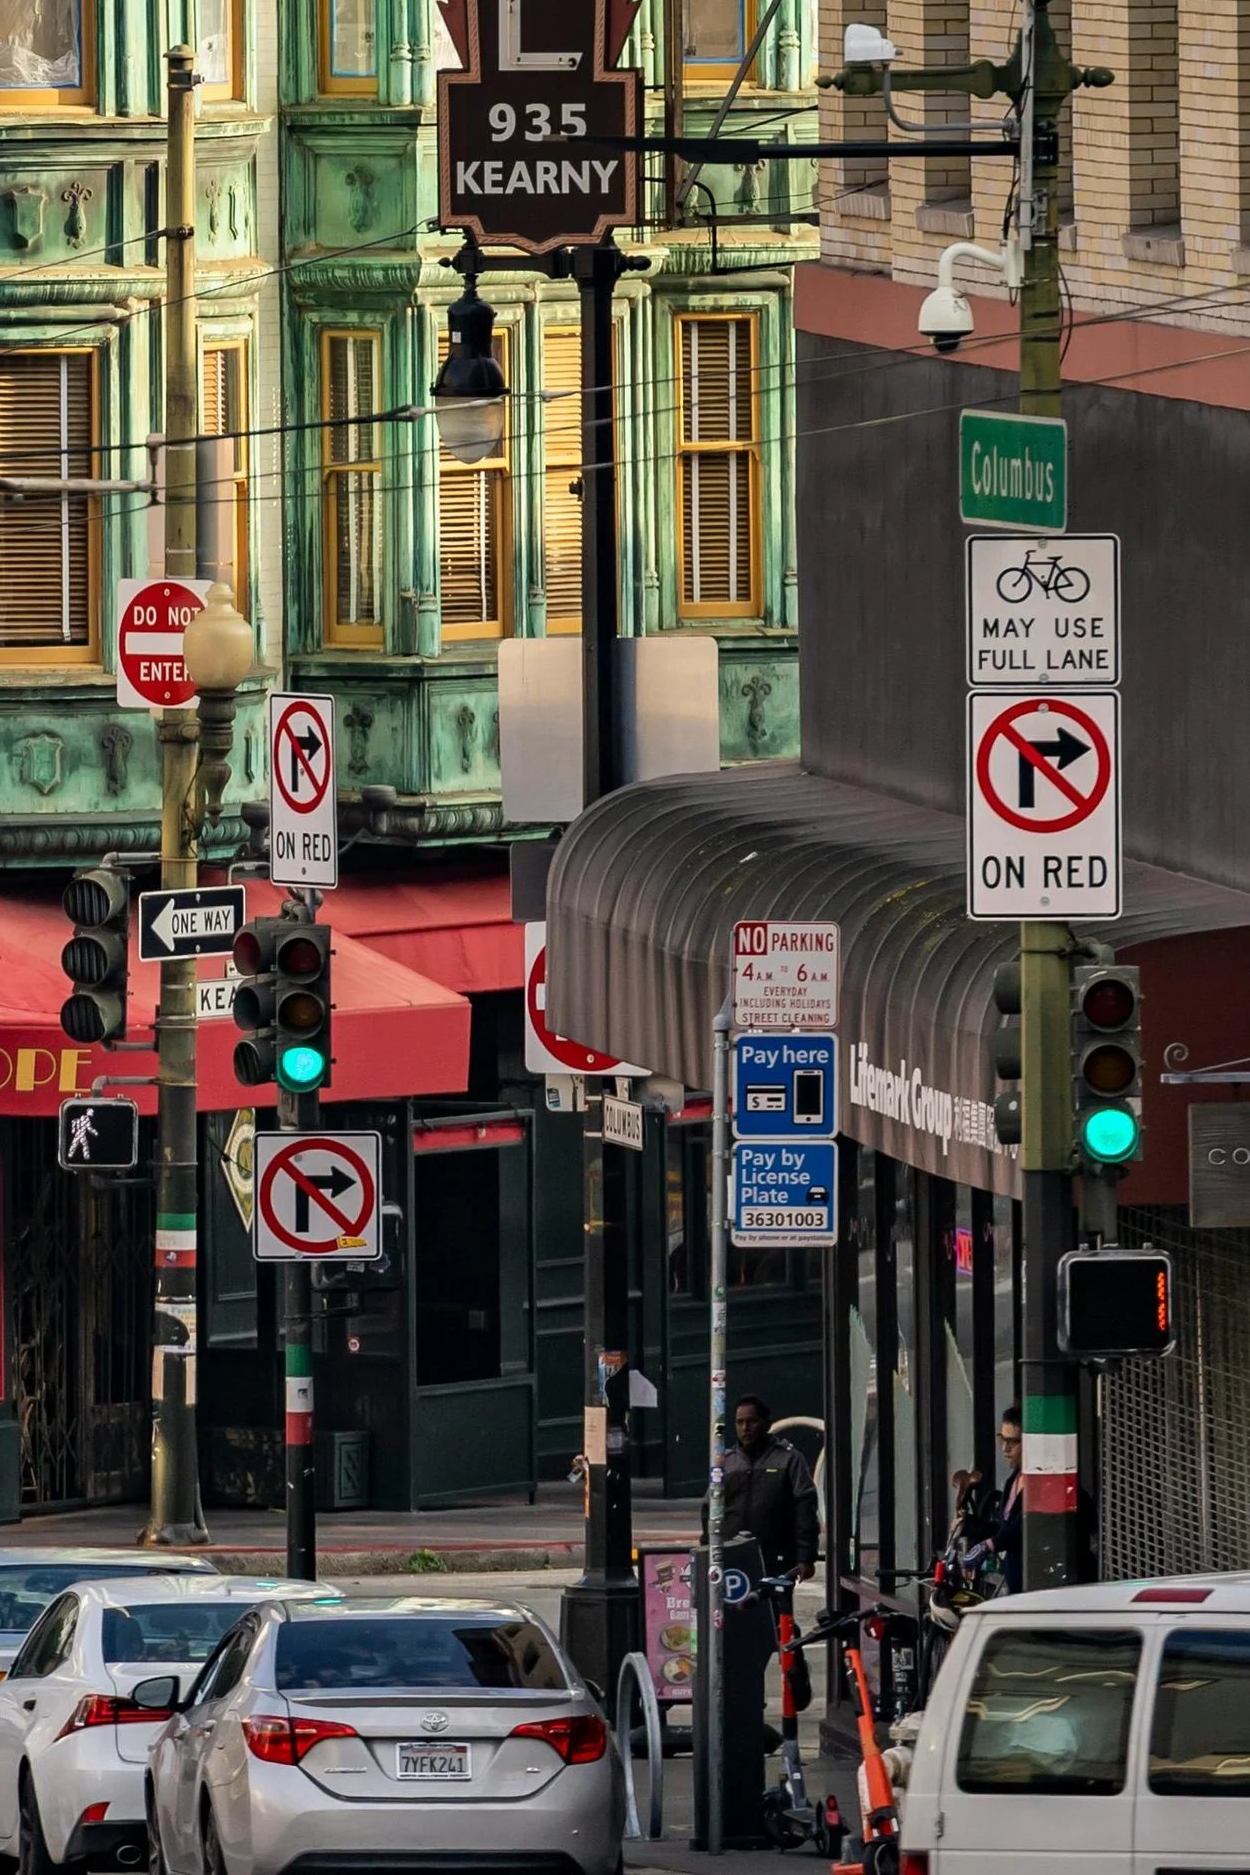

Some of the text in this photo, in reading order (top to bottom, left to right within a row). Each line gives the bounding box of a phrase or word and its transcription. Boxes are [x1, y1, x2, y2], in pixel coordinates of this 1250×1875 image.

[488, 102, 587, 142] 935
[456, 160, 619, 195] KEARNY
[971, 440, 1054, 503] Columbus
[133, 606, 157, 626] DO
[983, 617, 1104, 638] MAY USE
[979, 649, 1109, 670] FULL LANE
[276, 831, 331, 862] ON RED
[982, 855, 1107, 889] ON RED
[171, 909, 231, 935] ONE WAY
[738, 926, 834, 953] NO PARKING
[742, 962, 754, 981] 4
[797, 963, 808, 982] 6
[764, 987, 808, 996] EVERYDAY
[740, 998, 831, 1009] INCLUDING HOLIDAYS
[742, 1013, 830, 1024] STREET CLEANING
[742, 1045, 829, 1068] Pay here
[850, 1042, 910, 1125] Lifemark
[912, 1067, 952, 1156] Group
[605, 1105, 640, 1140] COLUMBUS
[742, 1149, 805, 1169] Pay by
[1208, 1147, 1250, 1165] CO
[742, 1169, 810, 1185] License
[741, 1188, 788, 1204] Plate
[745, 1212, 824, 1227] 36301003
[401, 1756, 466, 1773] 7YFK241
